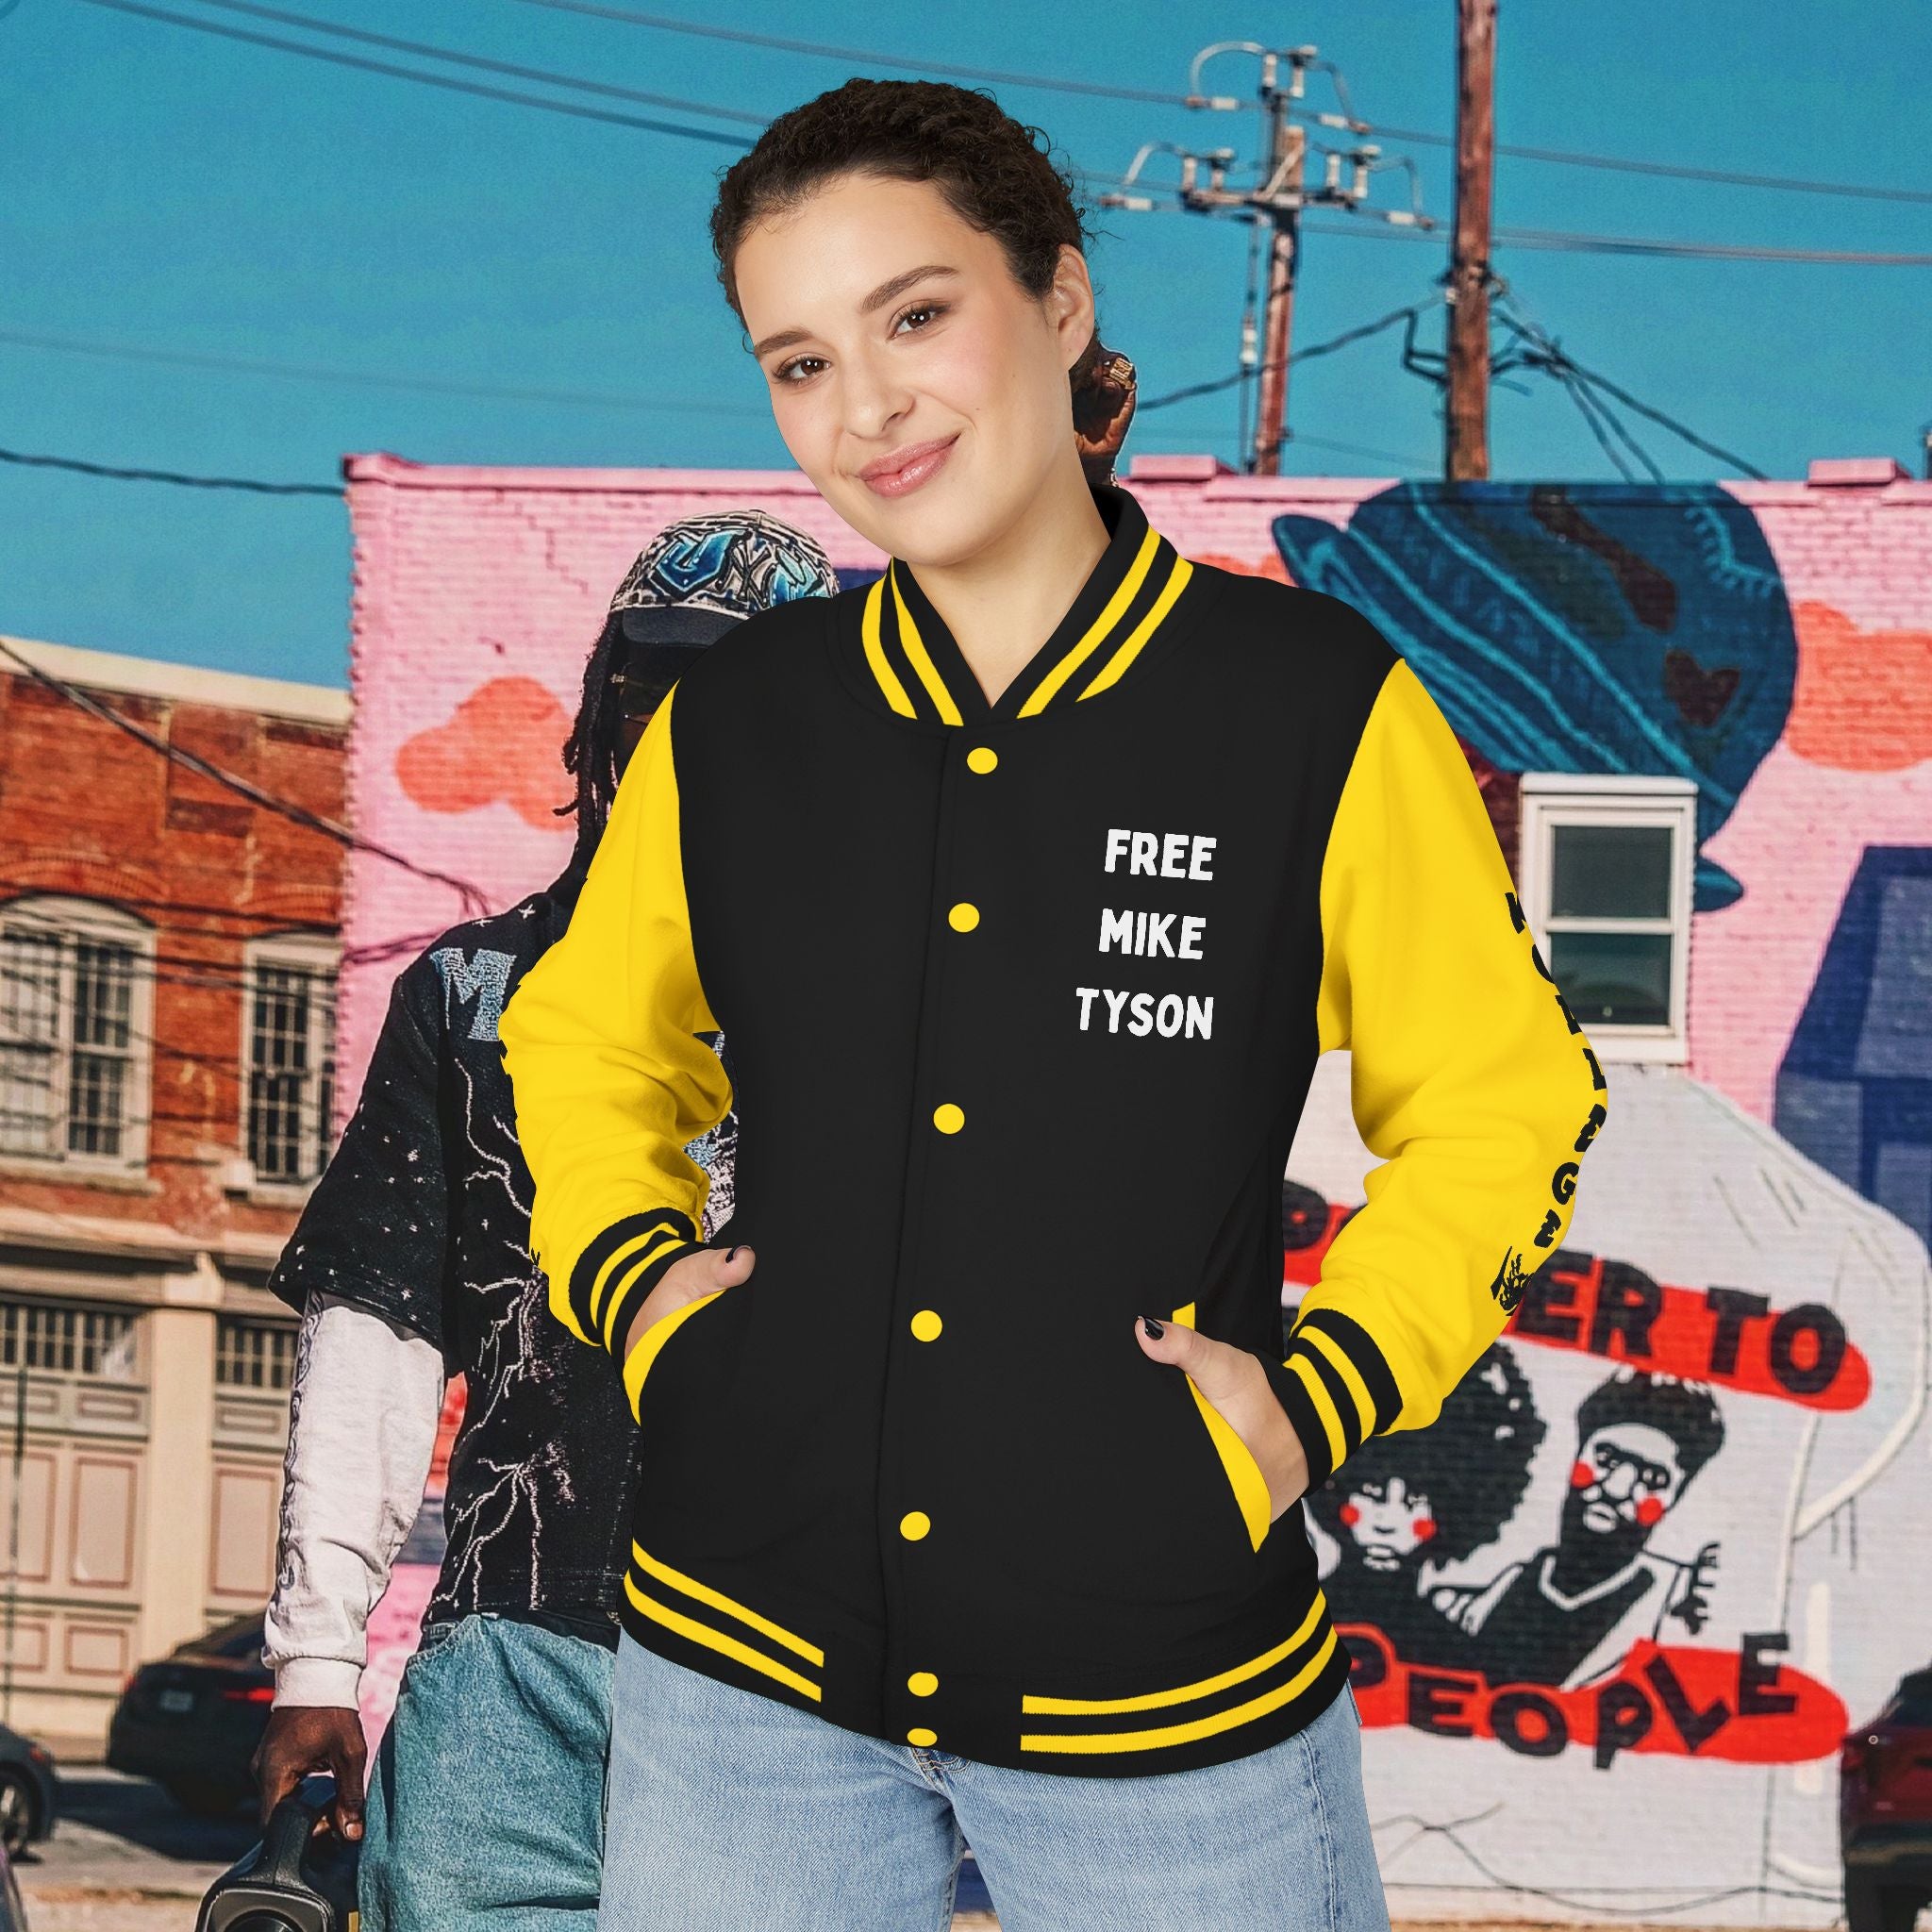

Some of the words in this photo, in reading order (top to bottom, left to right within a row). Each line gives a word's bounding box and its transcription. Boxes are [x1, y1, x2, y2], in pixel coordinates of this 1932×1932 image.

[1104, 828, 1217, 881] FREE
[1098, 908, 1207, 960] MIKE
[1075, 987, 1214, 1041] TYSON
[1706, 1286, 1846, 1396] TO
